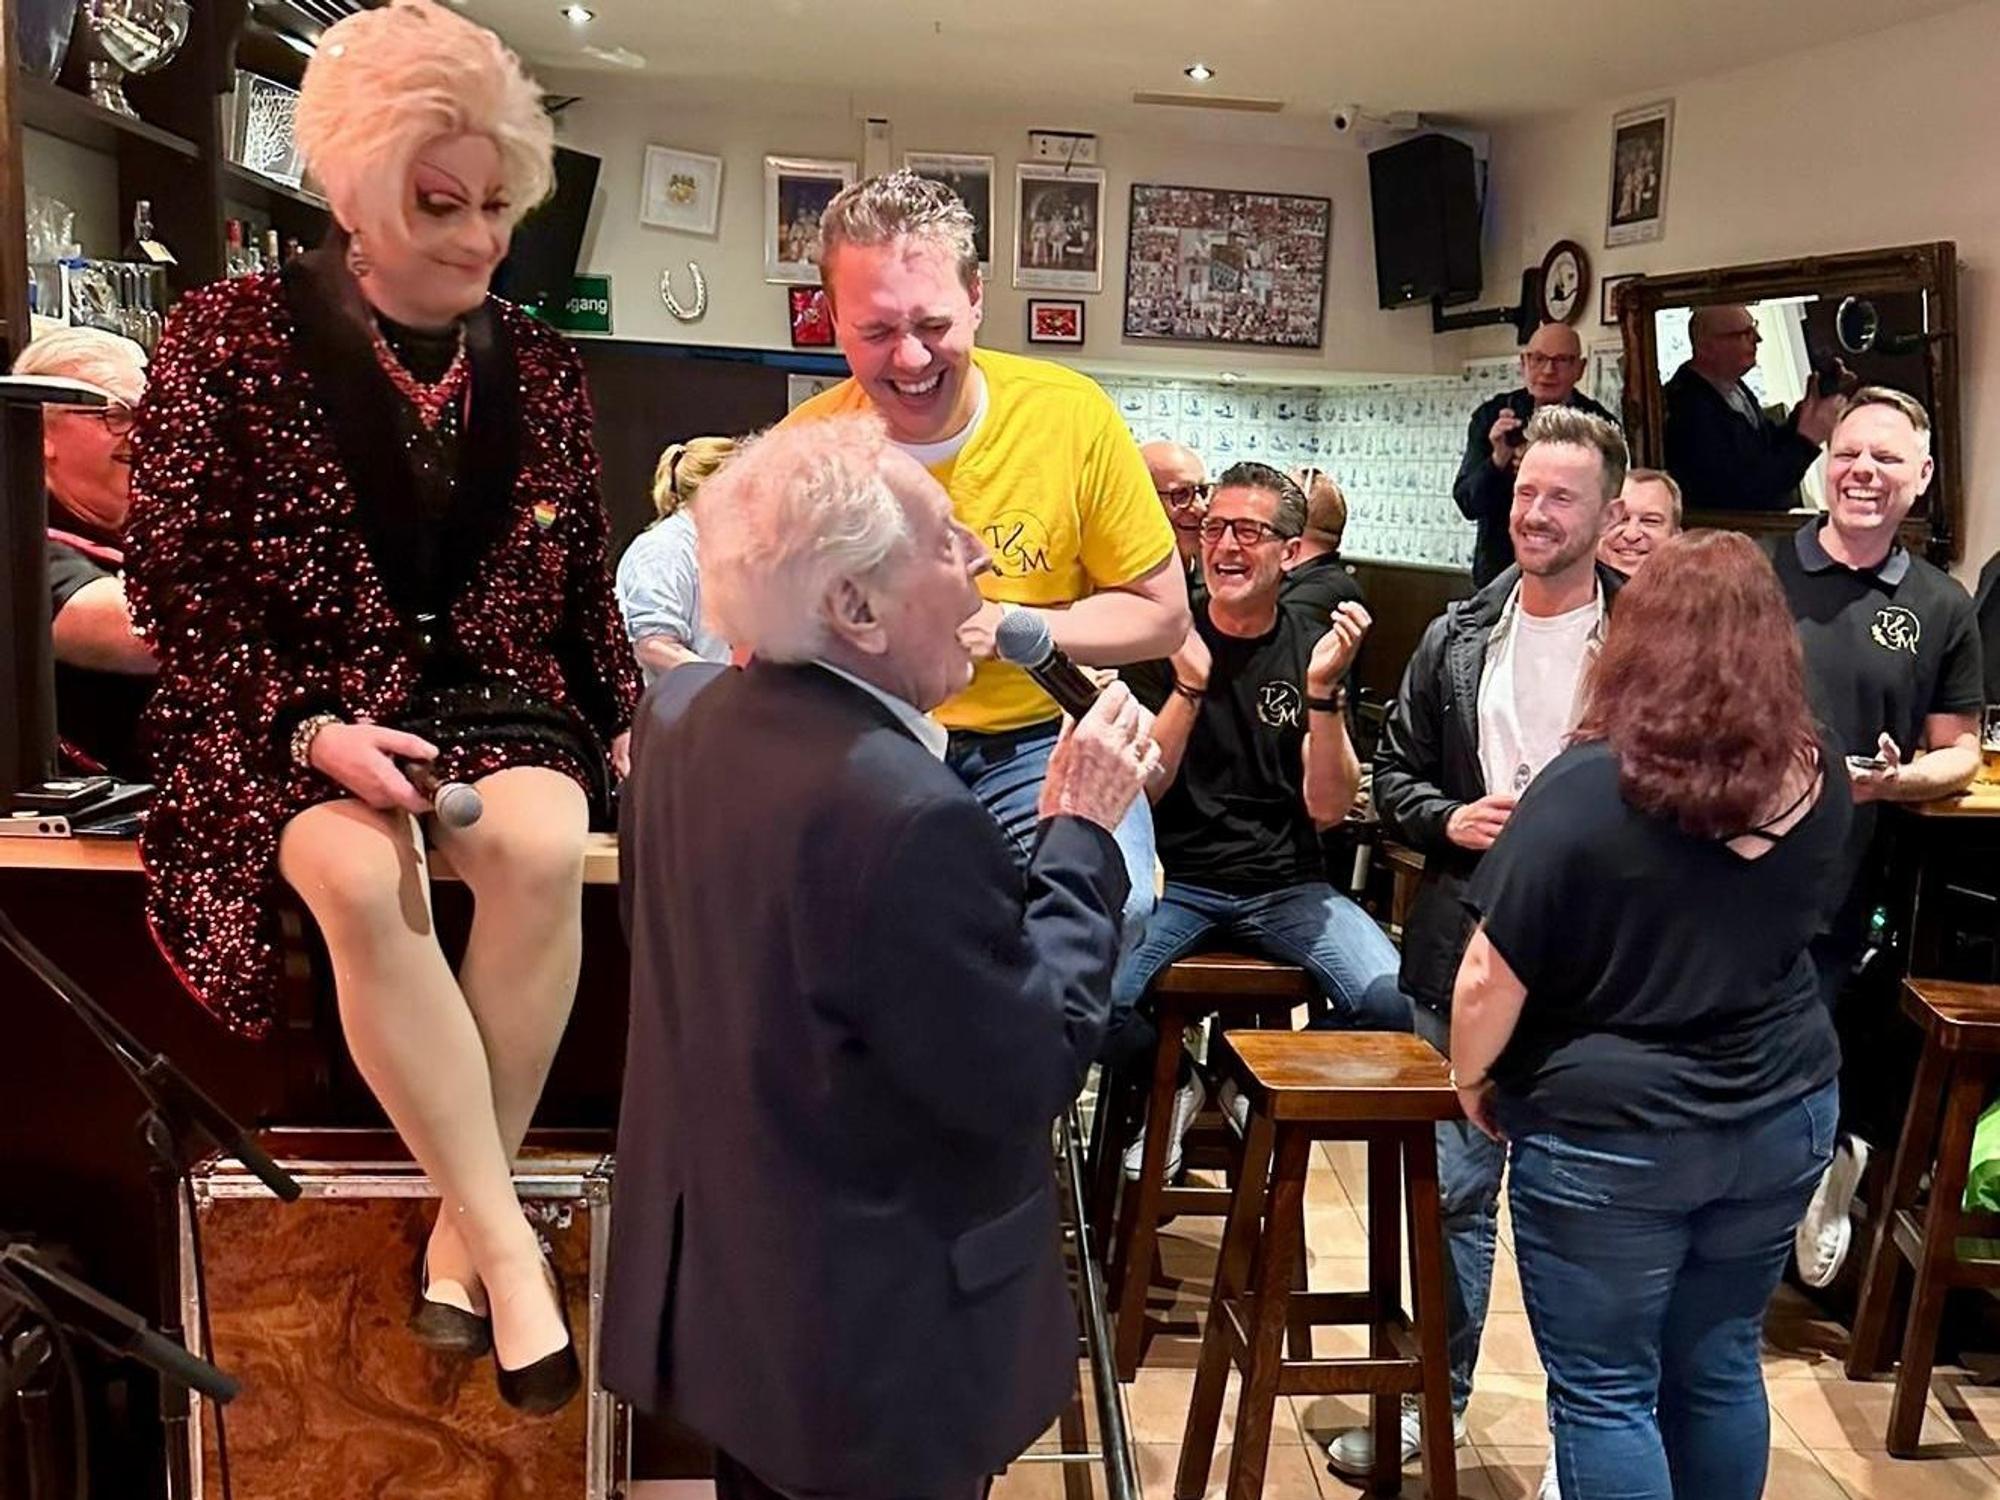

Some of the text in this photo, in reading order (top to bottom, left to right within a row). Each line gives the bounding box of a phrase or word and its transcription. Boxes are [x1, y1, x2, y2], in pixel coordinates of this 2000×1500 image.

[566, 298, 608, 315] gang
[1876, 610, 1917, 654] T&M
[1260, 686, 1298, 727] T&M
